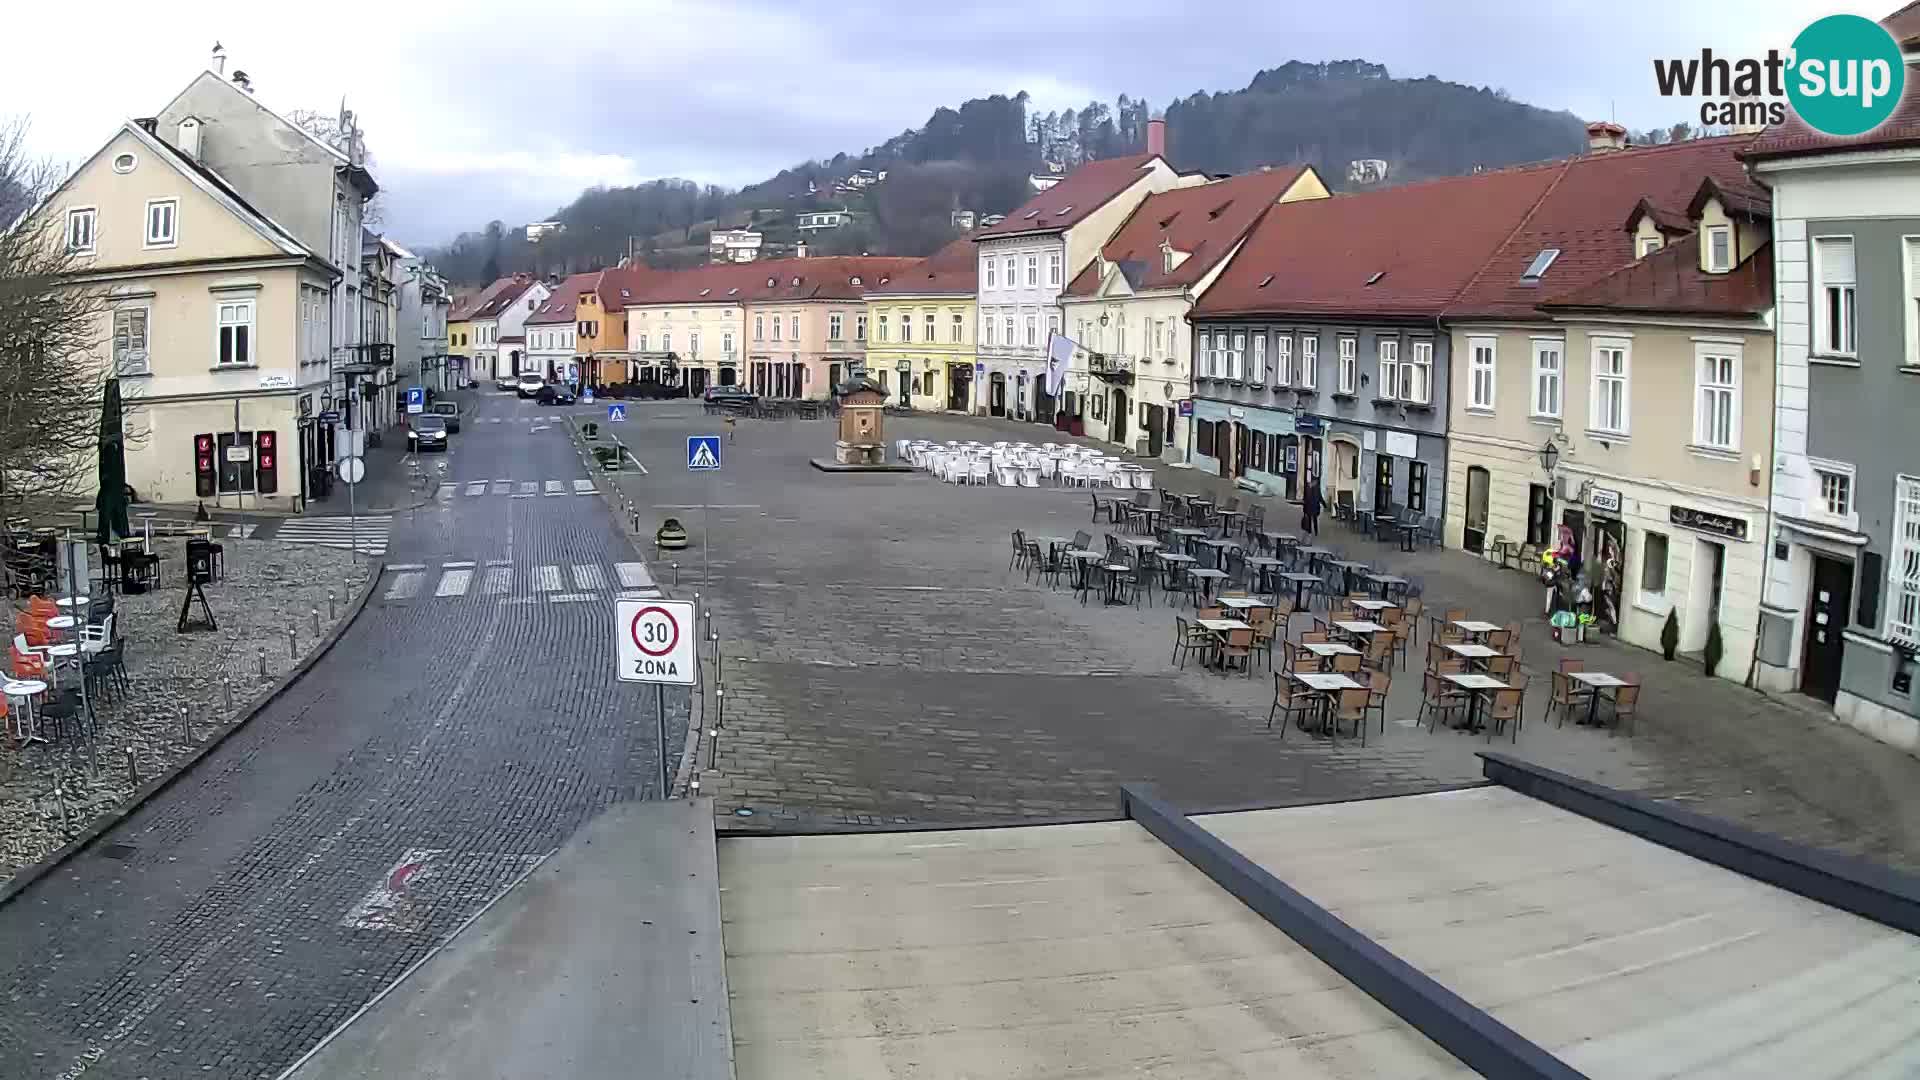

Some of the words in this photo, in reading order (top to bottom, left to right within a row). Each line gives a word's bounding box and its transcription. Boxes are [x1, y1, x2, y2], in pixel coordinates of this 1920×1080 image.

[411, 391, 419, 402] P
[644, 622, 668, 643] 30
[634, 659, 678, 676] ZONA
